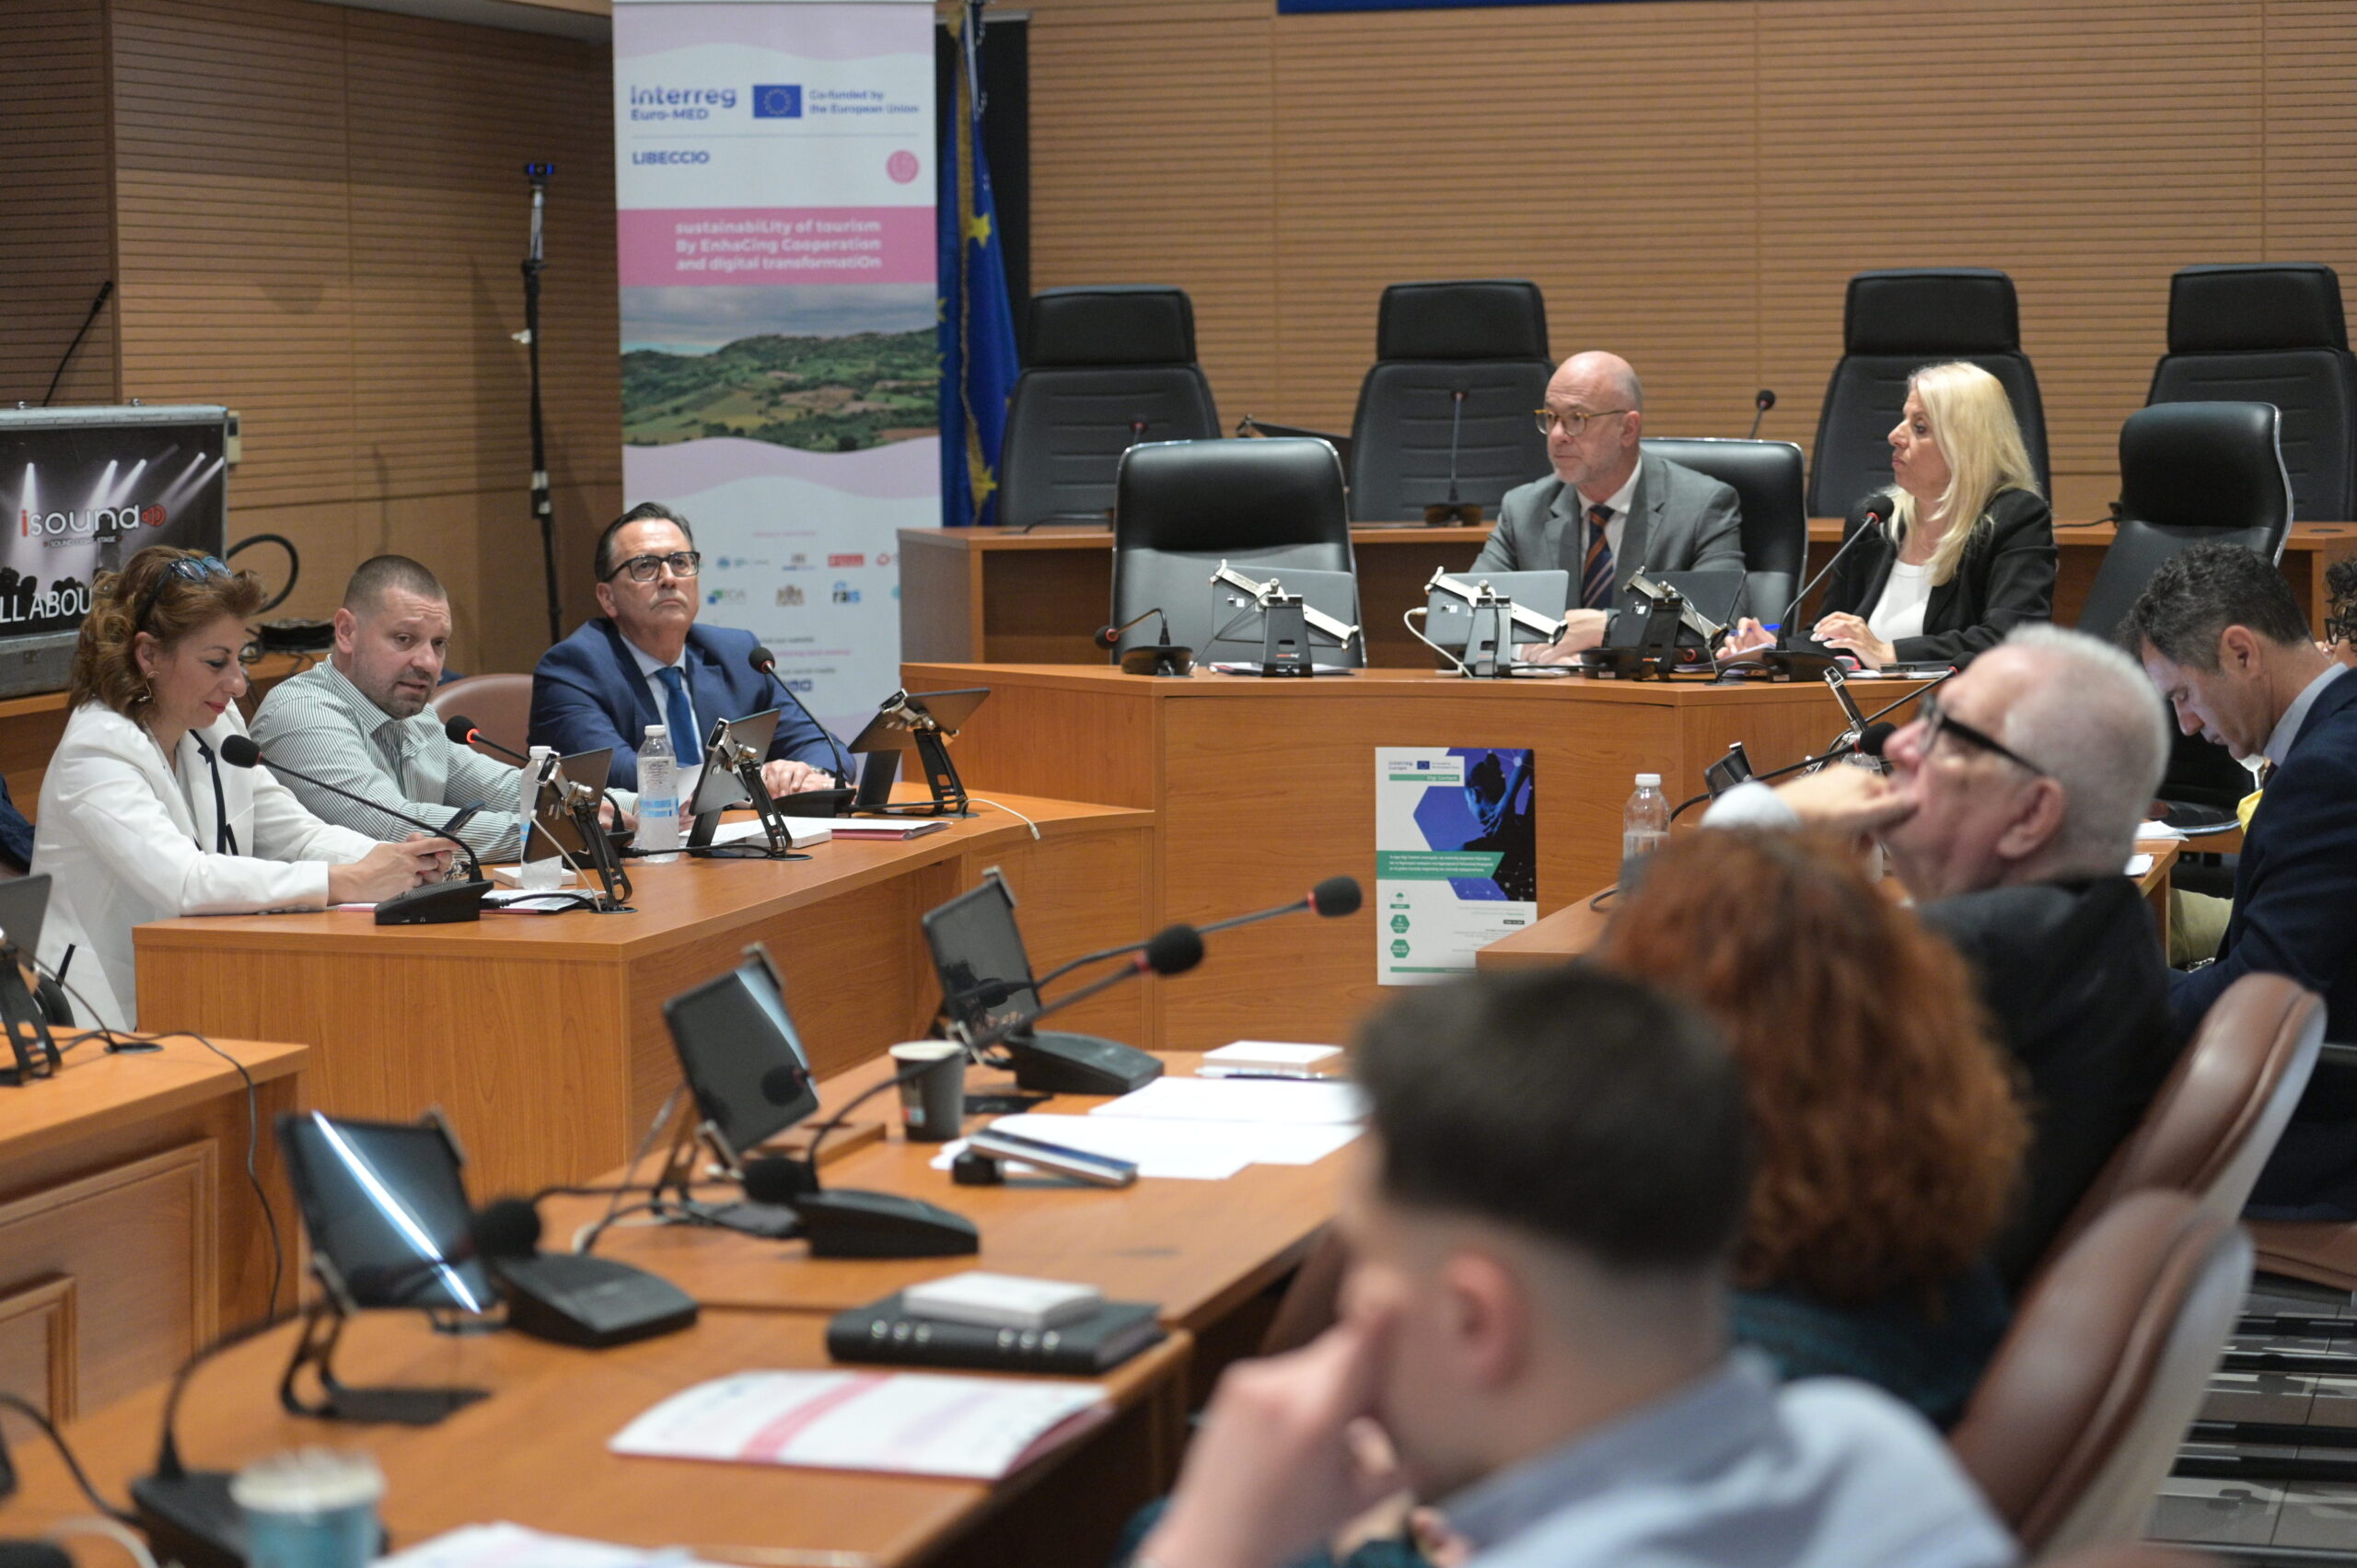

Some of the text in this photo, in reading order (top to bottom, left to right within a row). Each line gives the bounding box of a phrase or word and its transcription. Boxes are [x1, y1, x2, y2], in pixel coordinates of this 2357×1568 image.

[630, 85, 737, 109] Interreg
[631, 108, 709, 121] Euro-MED
[632, 150, 710, 165] LIBECCIO
[795, 219, 814, 232] of
[817, 219, 881, 232] tourism
[676, 239, 696, 254] By
[782, 238, 881, 252] Cooperation
[676, 258, 707, 271] and
